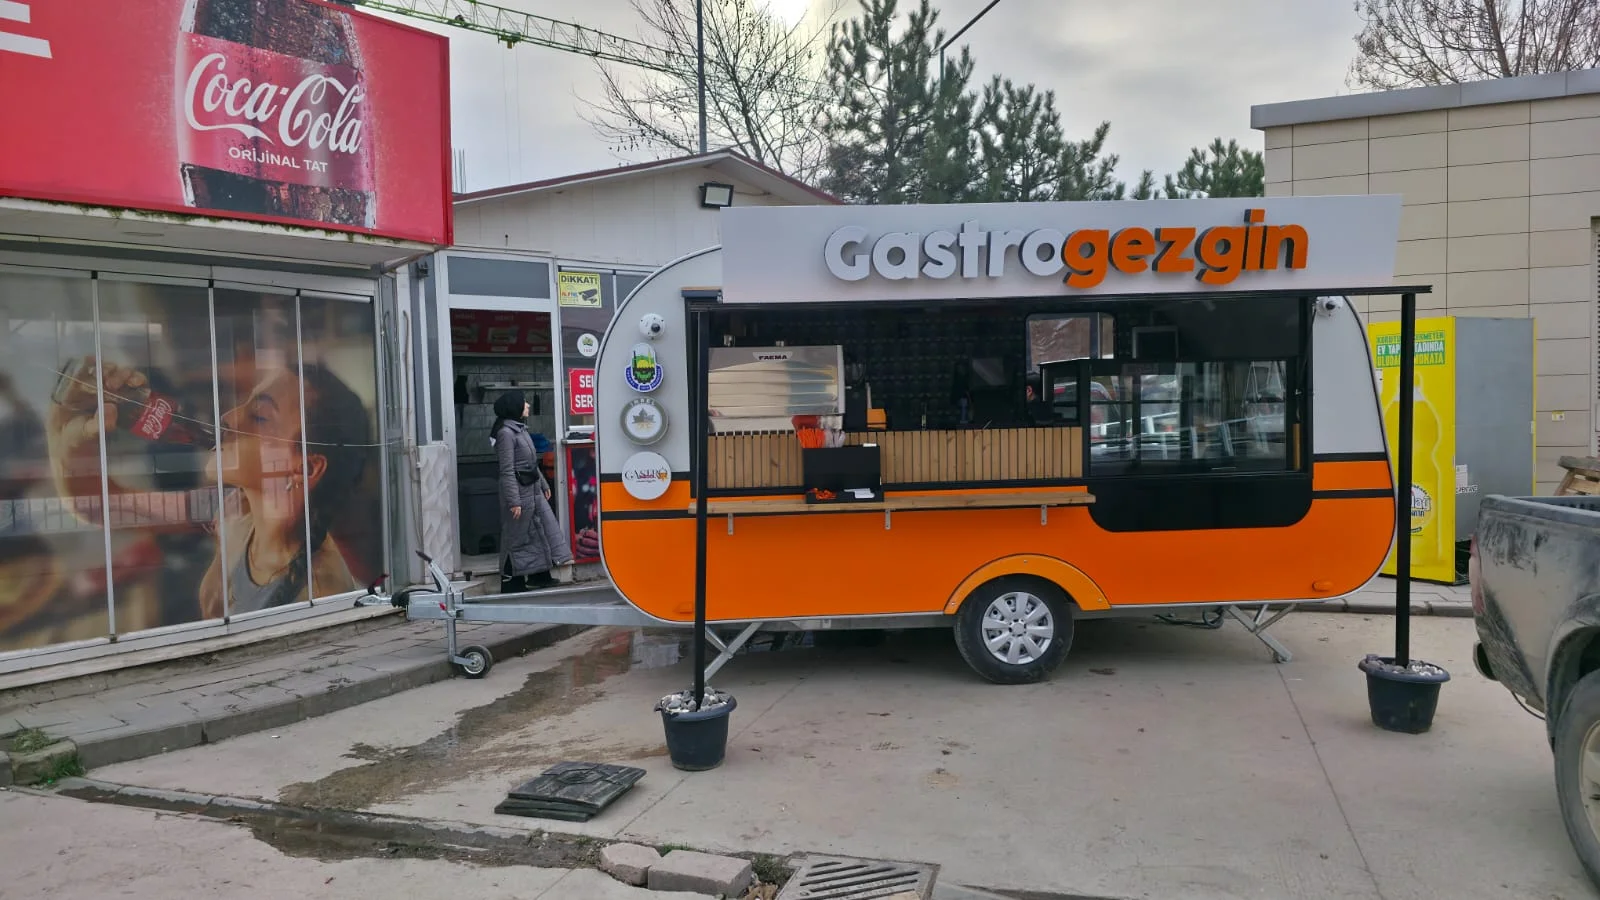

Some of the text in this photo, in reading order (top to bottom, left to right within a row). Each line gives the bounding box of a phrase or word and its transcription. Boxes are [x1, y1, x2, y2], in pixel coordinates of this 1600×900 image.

[184, 52, 365, 154] Coca-Cola
[228, 147, 328, 173] ORİJİNAL TAT
[824, 209, 1309, 289] Gastrogezgin
